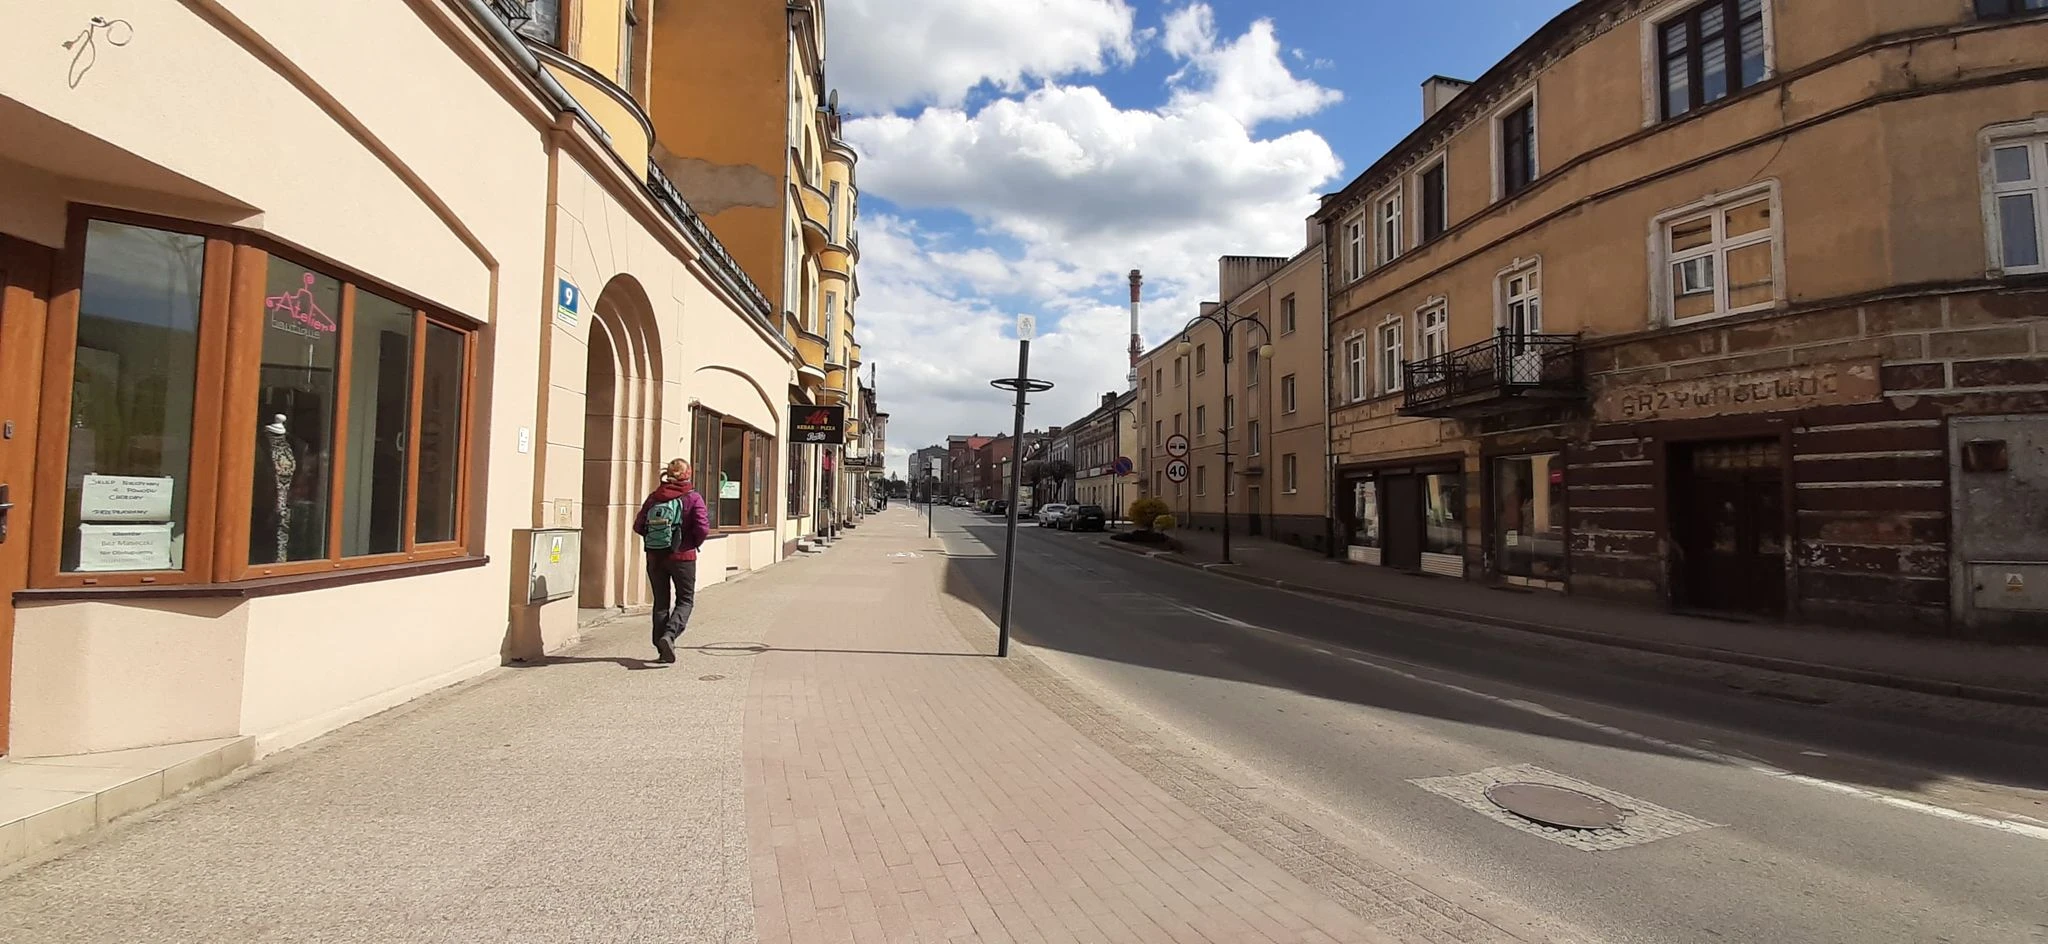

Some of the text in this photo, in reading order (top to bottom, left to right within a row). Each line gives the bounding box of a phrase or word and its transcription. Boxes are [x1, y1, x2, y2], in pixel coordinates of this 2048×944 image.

[565, 287, 573, 305] 9
[276, 291, 329, 331] Atelier
[271, 308, 321, 339] boutique
[1169, 465, 1186, 477] 40
